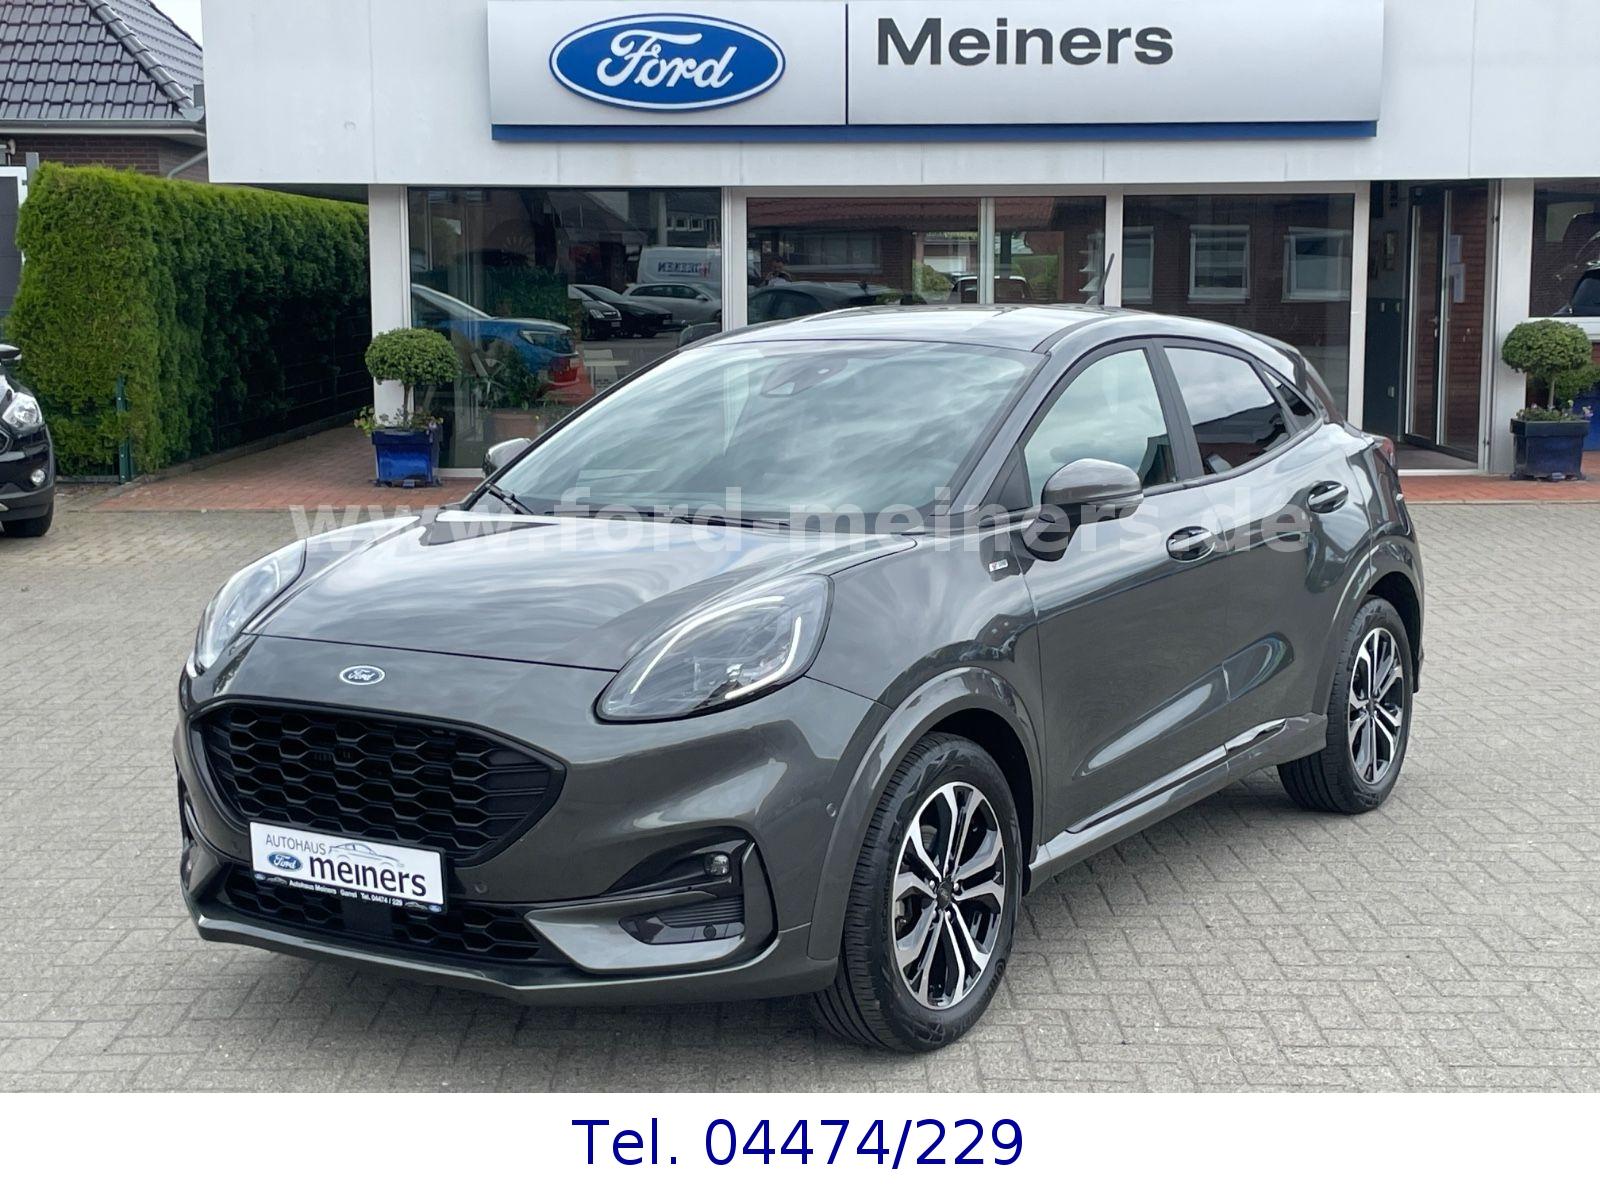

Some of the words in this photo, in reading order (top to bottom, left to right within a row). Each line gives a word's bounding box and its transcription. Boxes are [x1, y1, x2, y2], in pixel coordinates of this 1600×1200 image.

[597, 29, 738, 89] Ford
[877, 18, 1173, 66] Meiners
[265, 833, 327, 855] AUTOHAUS
[273, 855, 297, 871] Ford
[309, 855, 427, 897] meiners
